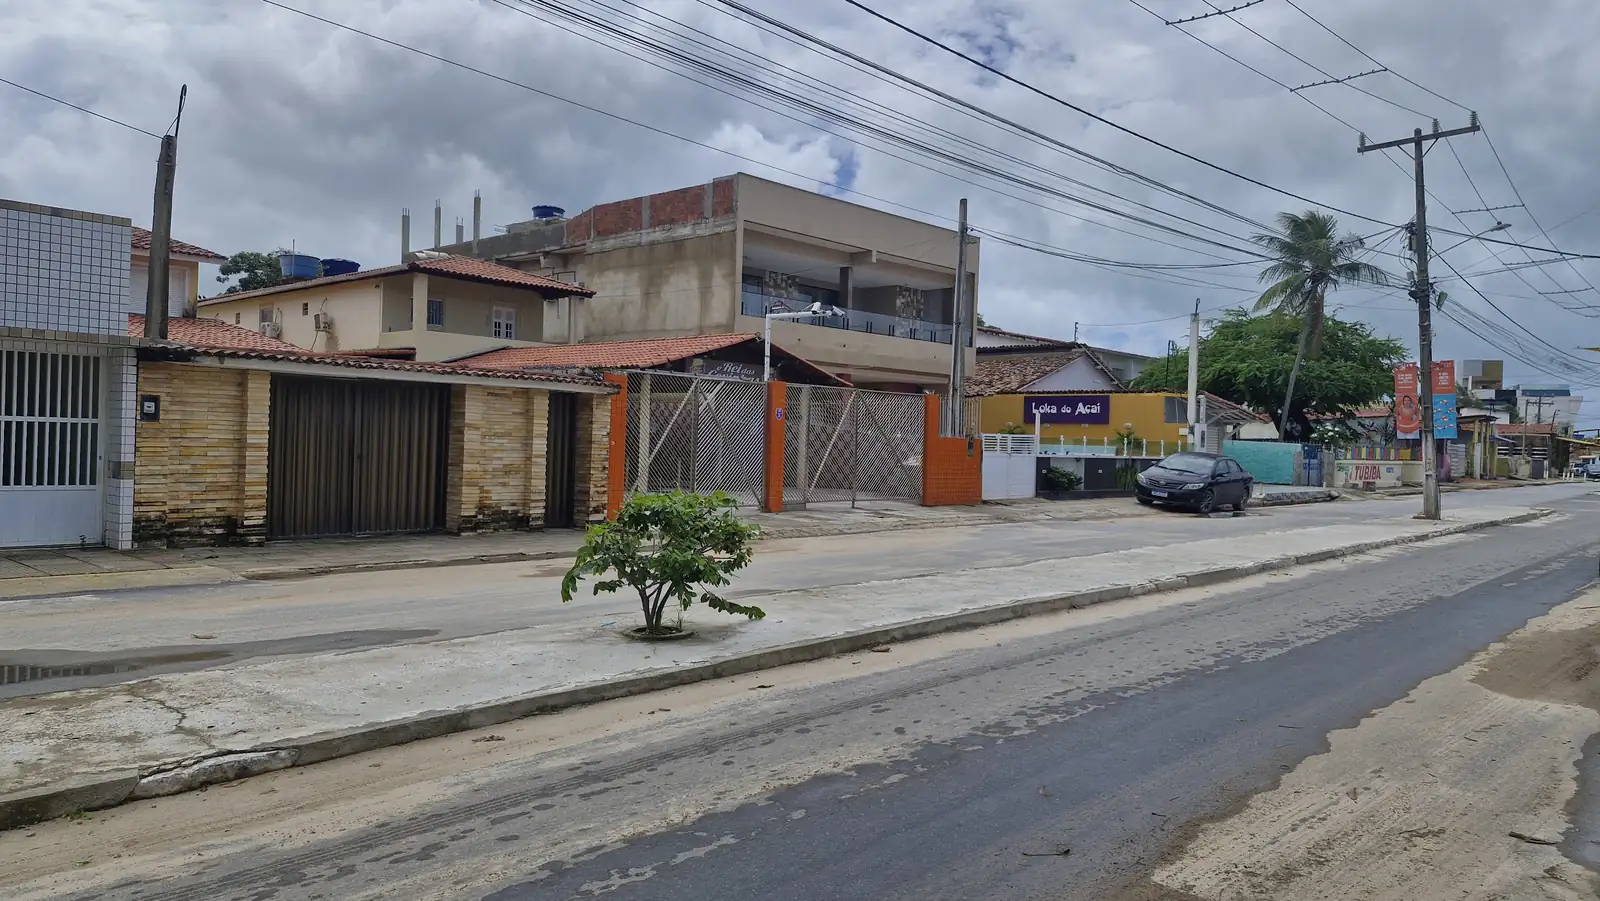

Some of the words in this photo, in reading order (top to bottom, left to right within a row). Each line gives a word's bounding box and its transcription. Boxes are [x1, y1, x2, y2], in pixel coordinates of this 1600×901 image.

[723, 362, 743, 373] Rei
[1032, 402, 1057, 413] Loka
[1061, 405, 1072, 413] do
